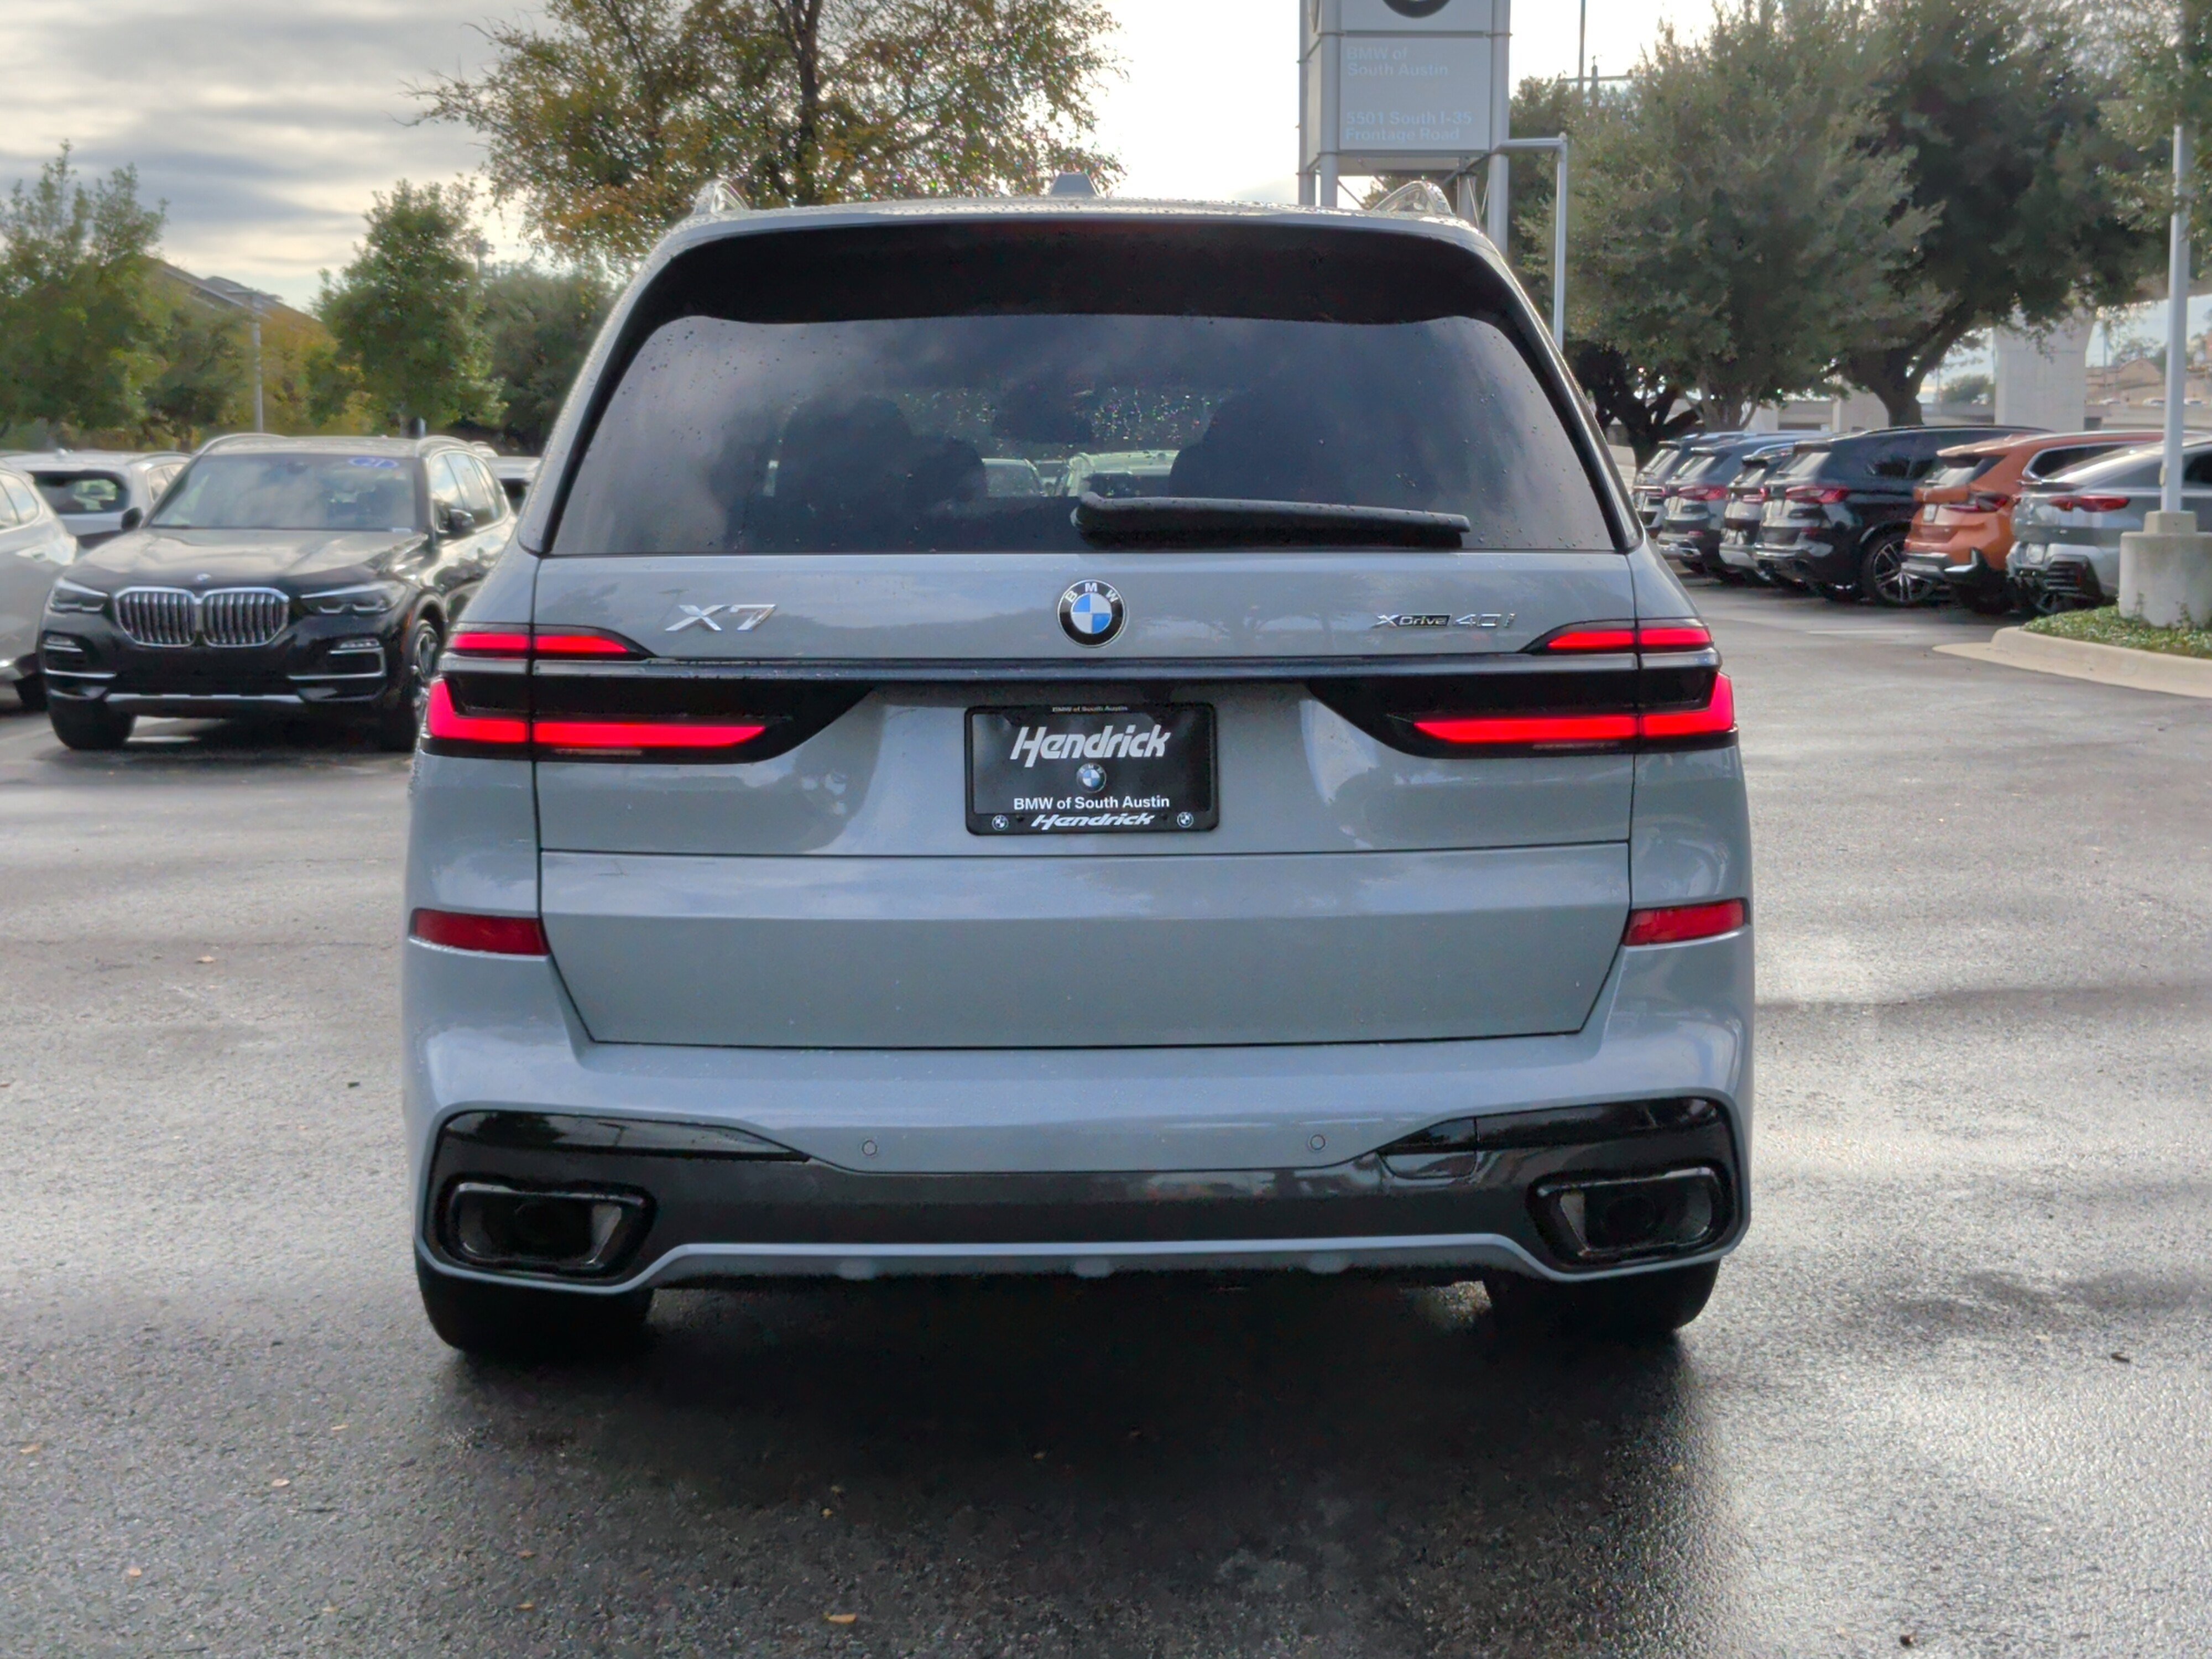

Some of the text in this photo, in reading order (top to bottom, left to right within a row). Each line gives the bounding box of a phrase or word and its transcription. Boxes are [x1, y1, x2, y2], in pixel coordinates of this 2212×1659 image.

[1347, 46, 1408, 60] BMW of
[1348, 62, 1449, 76] South Austin
[1346, 110, 1472, 124] 5501 South I-35
[1345, 127, 1460, 143] Frontage Road
[1064, 582, 1119, 603] BMW
[665, 604, 778, 631] X7
[1010, 724, 1171, 768] Hendrick
[1014, 795, 1170, 810] BMW of South Austin
[1031, 812, 1155, 830] Hendrick
